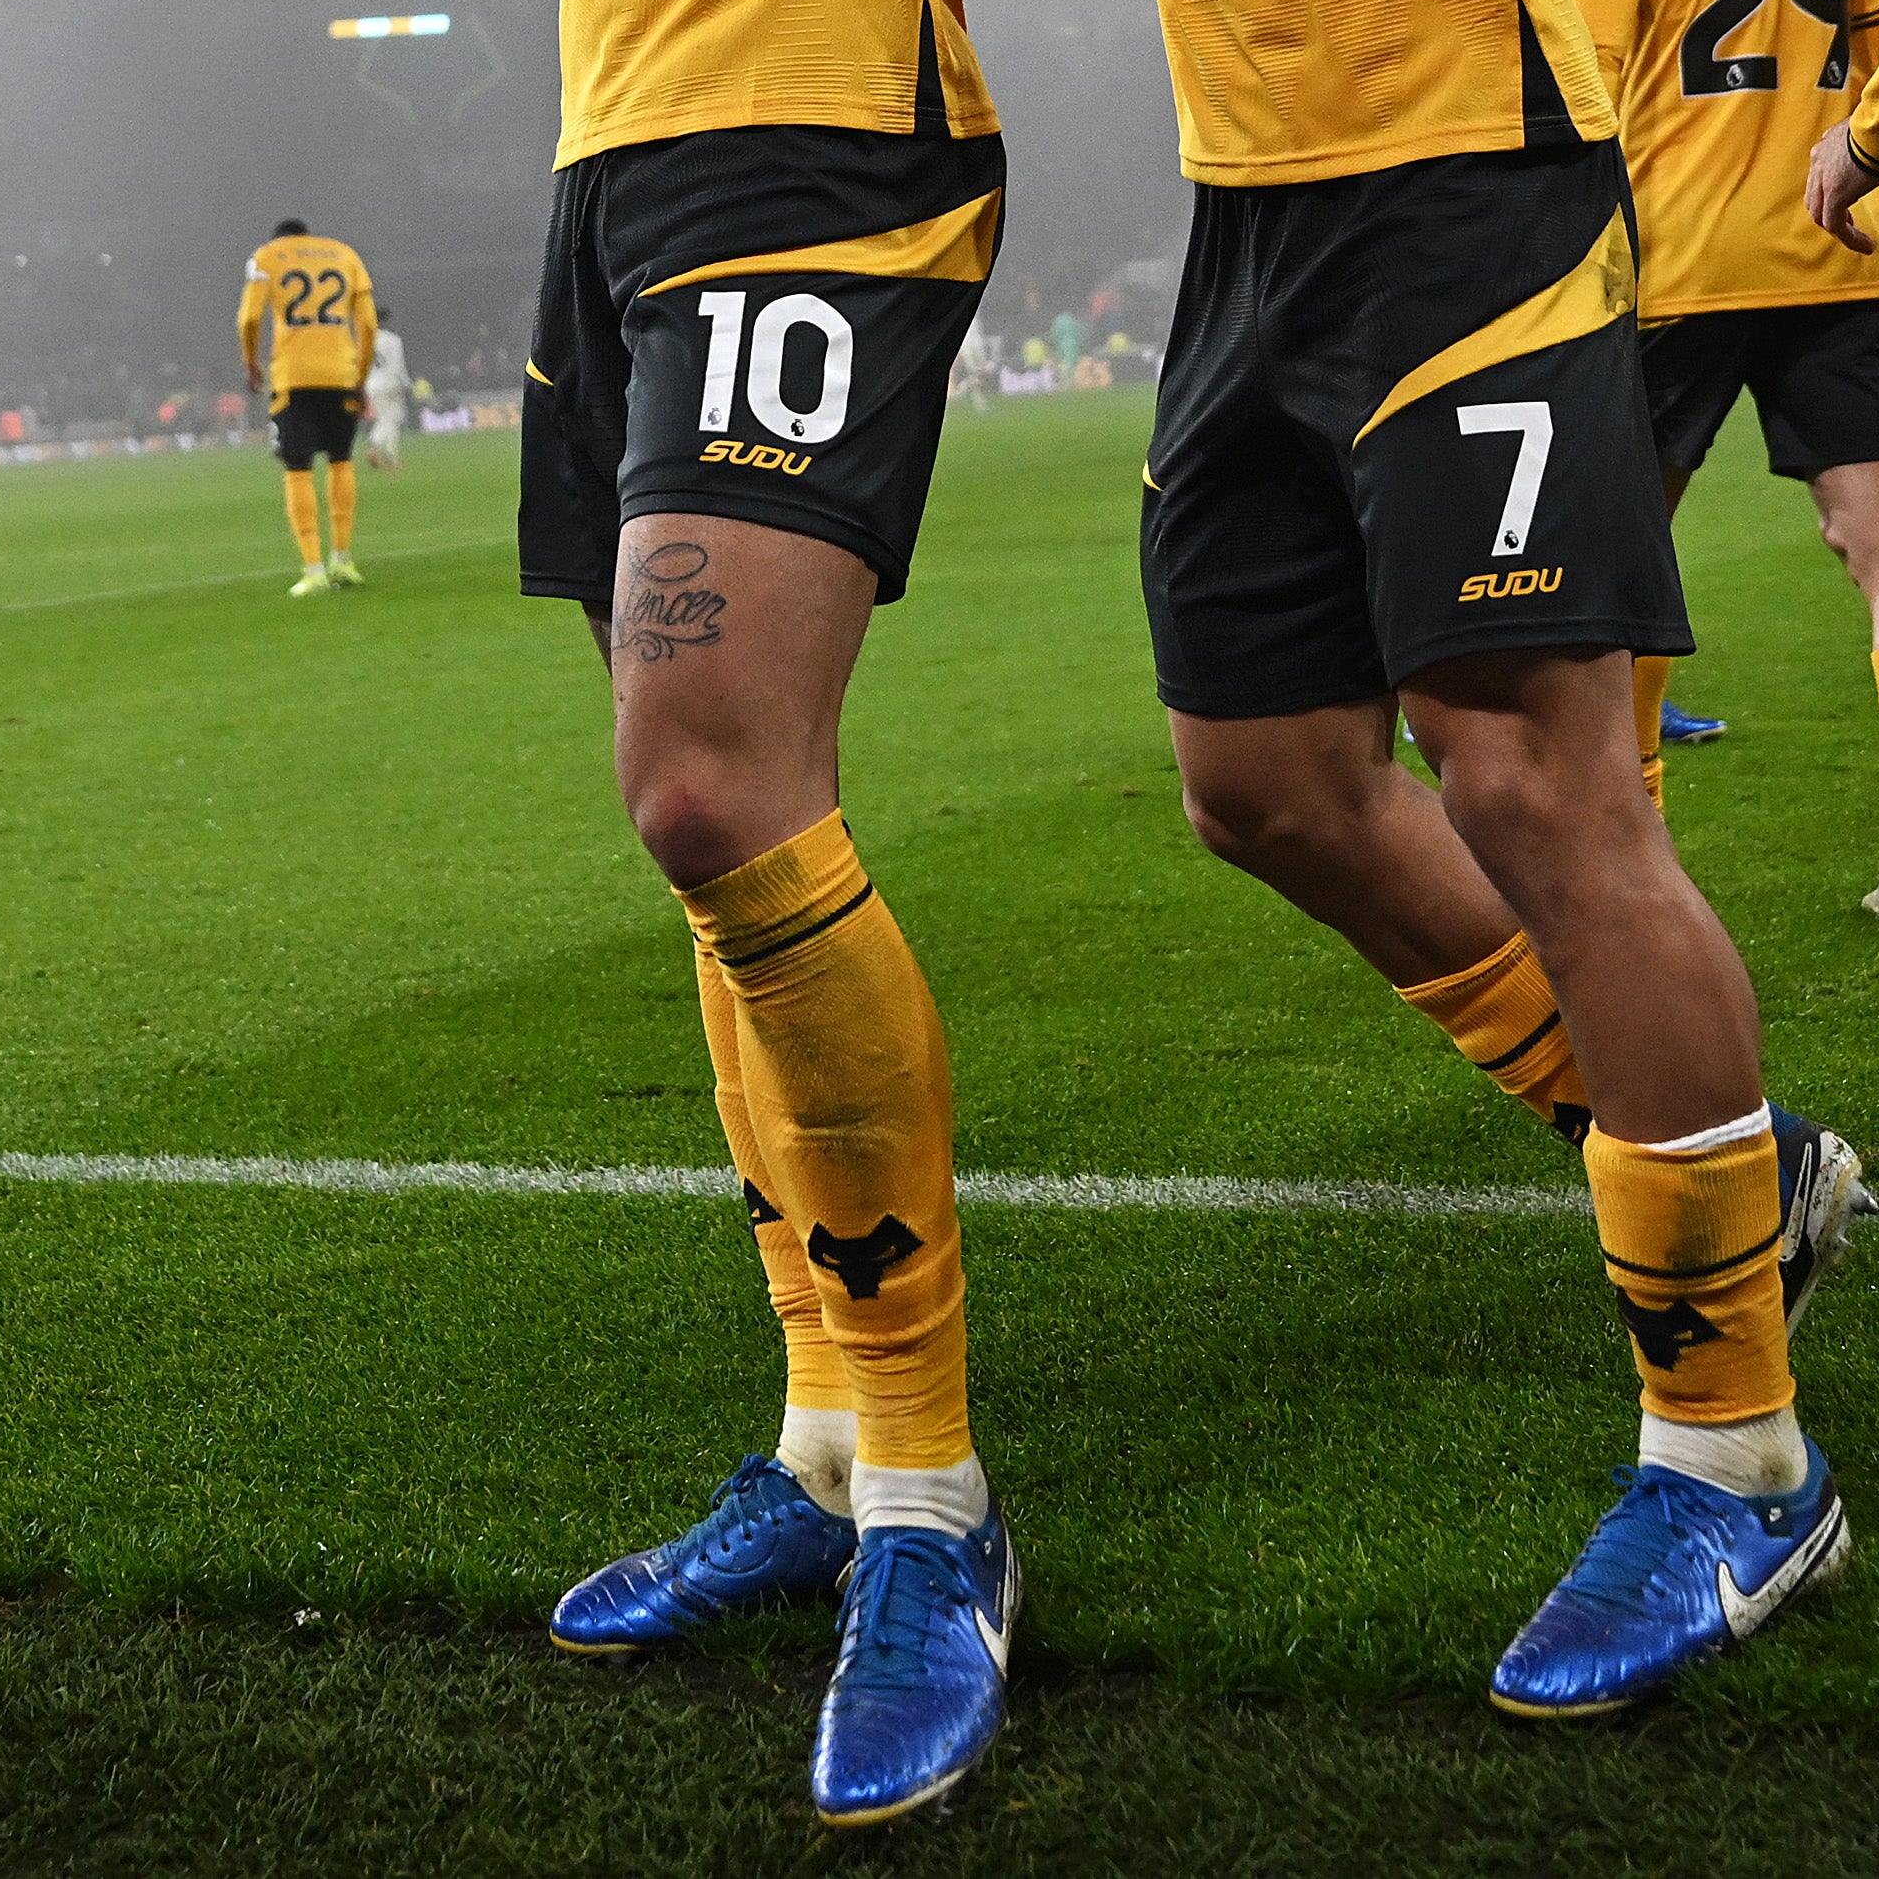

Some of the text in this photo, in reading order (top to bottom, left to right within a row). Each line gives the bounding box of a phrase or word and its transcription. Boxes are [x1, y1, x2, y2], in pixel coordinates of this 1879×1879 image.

[279, 268, 346, 326] 22
[698, 291, 854, 445] 10
[699, 440, 813, 476] SUDU
[1456, 401, 1554, 557] 7
[1457, 567, 1564, 602] SUDU
